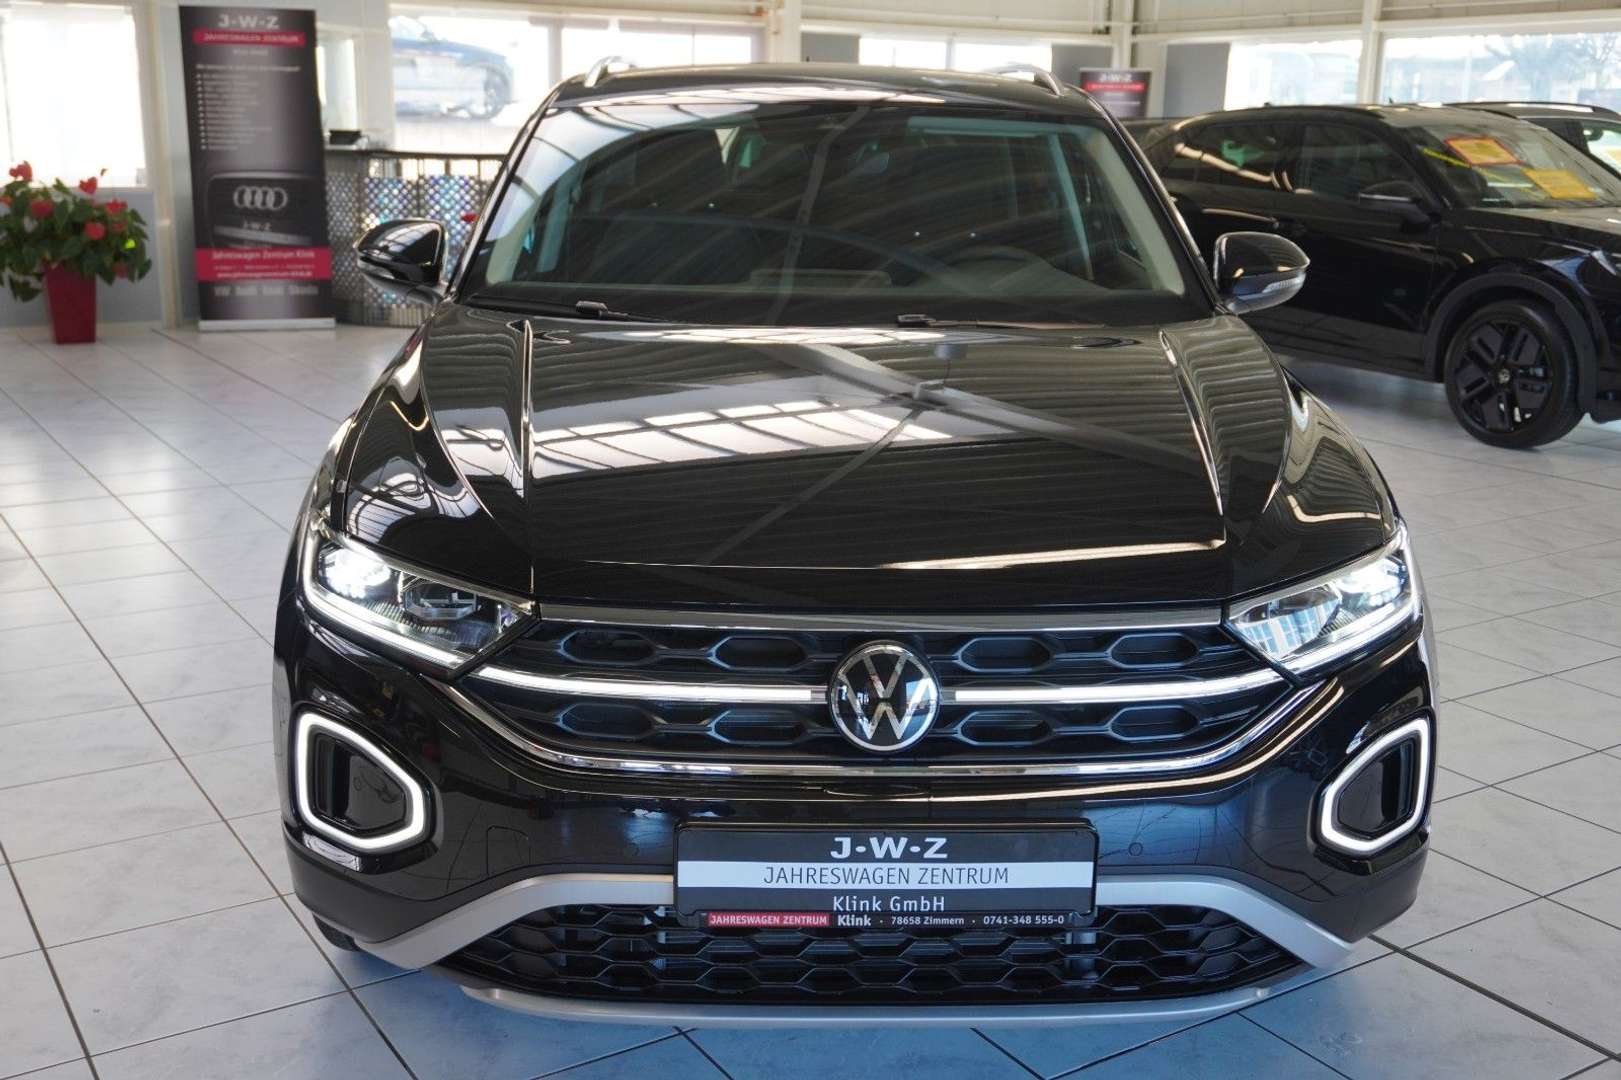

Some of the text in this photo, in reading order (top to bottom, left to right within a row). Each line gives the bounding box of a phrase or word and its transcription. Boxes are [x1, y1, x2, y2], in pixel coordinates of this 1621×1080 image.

[764, 867, 1009, 884] JAHRESWAGEN ZENTRUM
[833, 896, 945, 912] Klink GmbH
[709, 914, 1065, 926] JAHRESWAGEN ZENTRUM Klink 78658 Zimmern 0741-348 555-0
